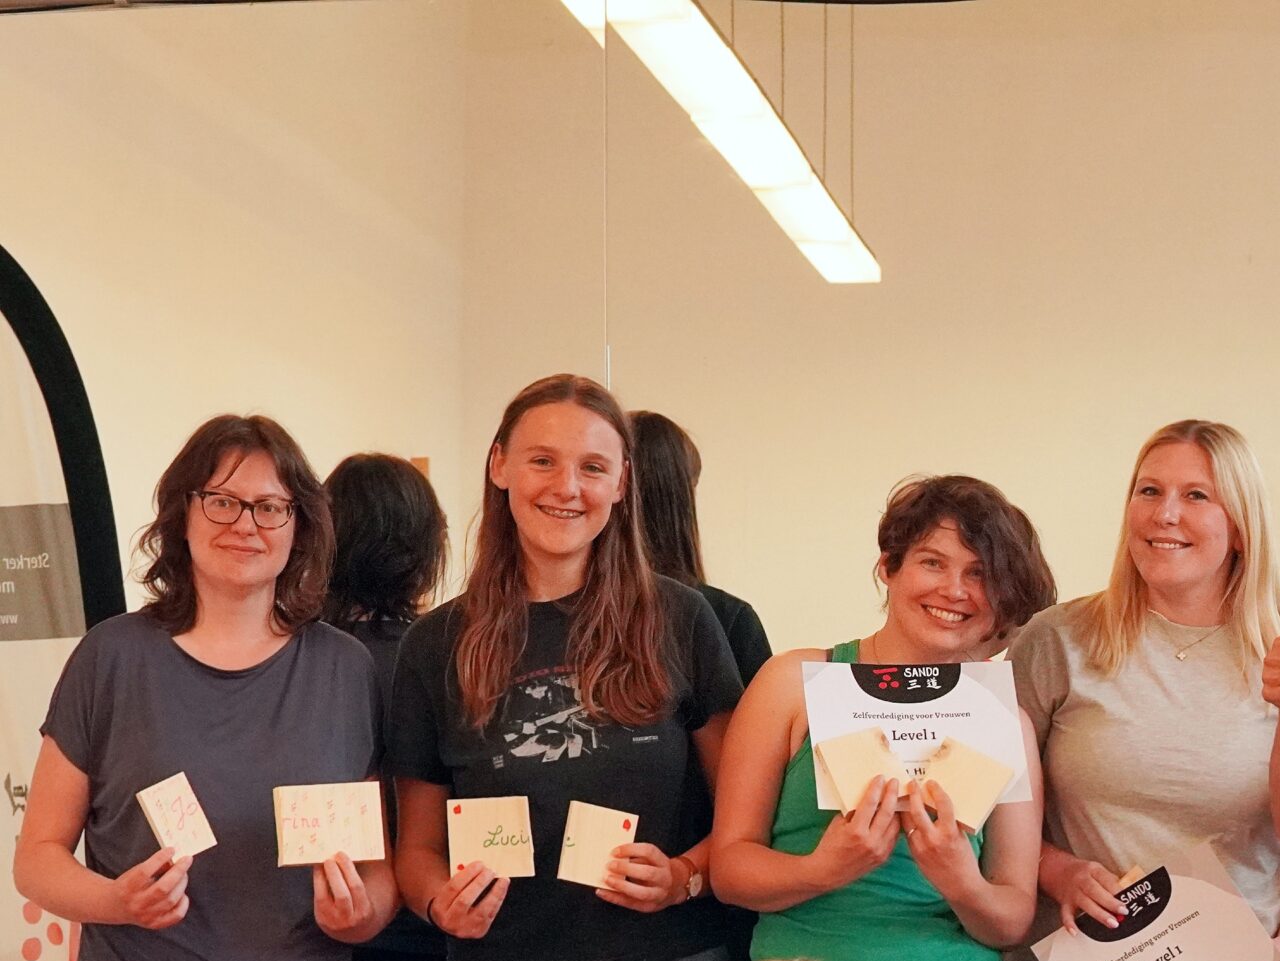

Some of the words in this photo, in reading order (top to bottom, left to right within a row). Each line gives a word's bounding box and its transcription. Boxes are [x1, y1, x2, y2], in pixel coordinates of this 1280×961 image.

[903, 667, 940, 678] SANDO
[853, 711, 915, 721] Zelfverdediging
[892, 729, 928, 741] Level
[931, 731, 937, 740] 1
[172, 796, 198, 831] Jo
[1120, 880, 1152, 905] SANDO
[1153, 929, 1169, 942] voor
[1168, 910, 1200, 931] Vrouwen
